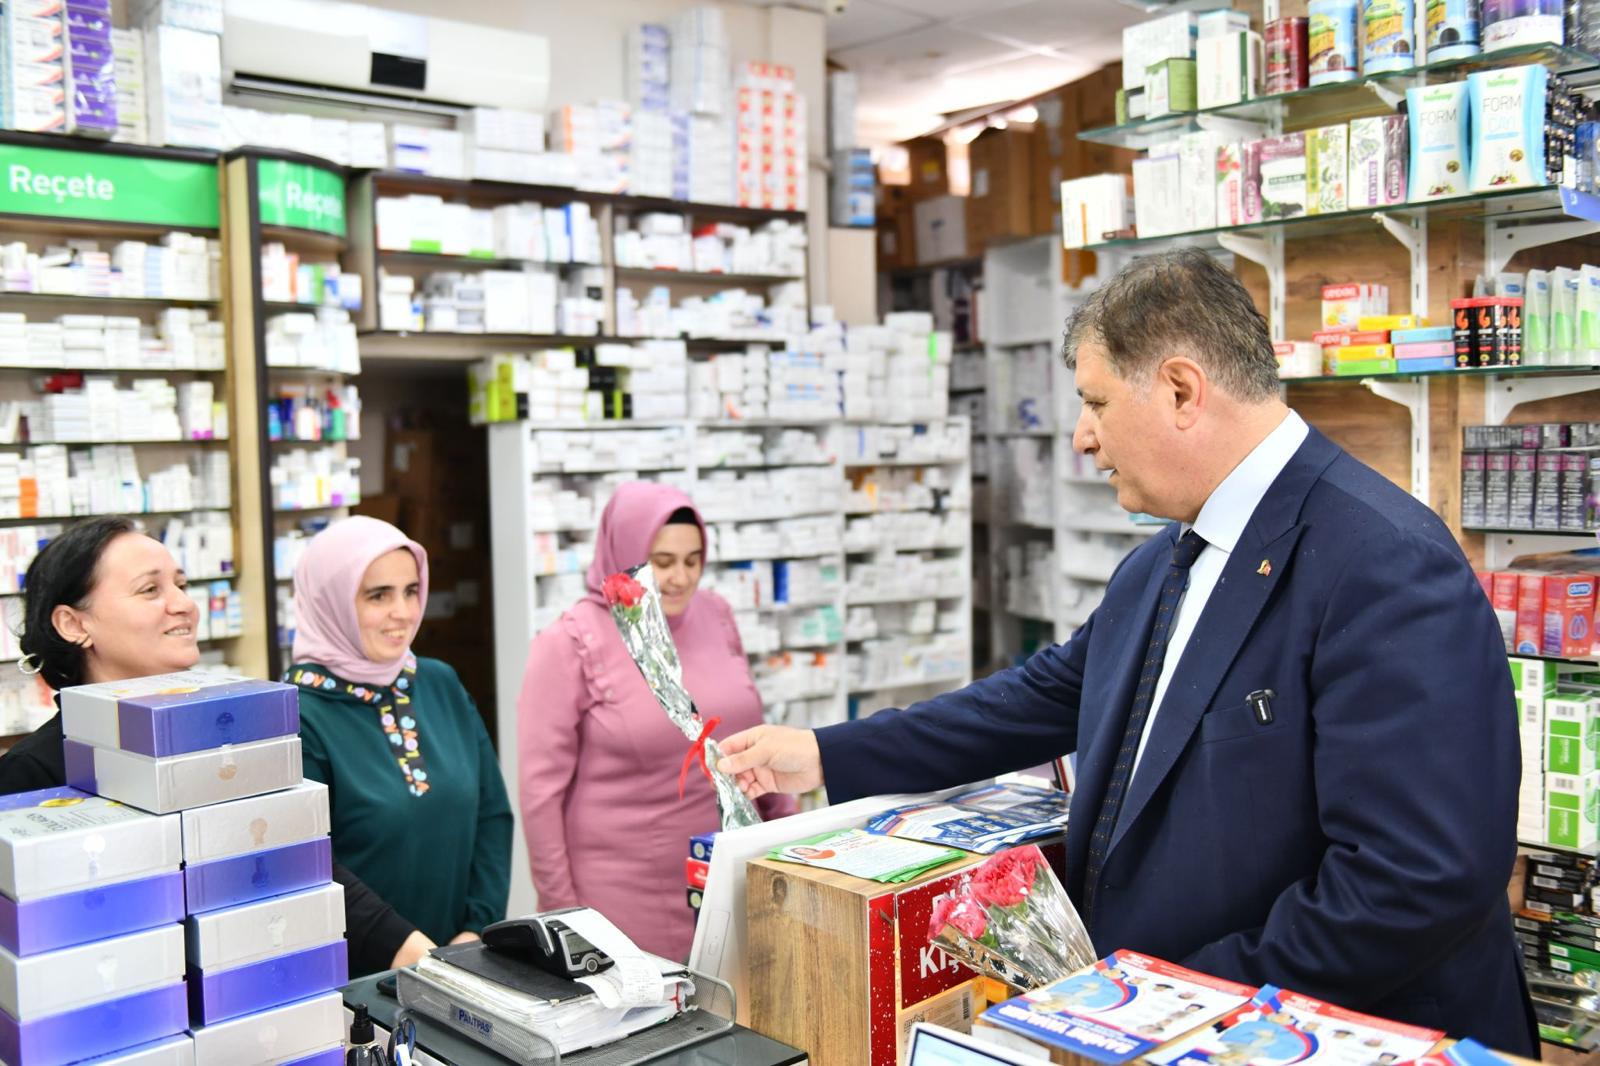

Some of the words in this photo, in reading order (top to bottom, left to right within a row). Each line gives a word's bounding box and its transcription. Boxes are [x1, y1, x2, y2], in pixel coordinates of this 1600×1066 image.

[1419, 108, 1457, 126] FORM
[1482, 94, 1522, 113] FORM
[9, 165, 114, 203] Reçete
[285, 182, 342, 219] Reçete
